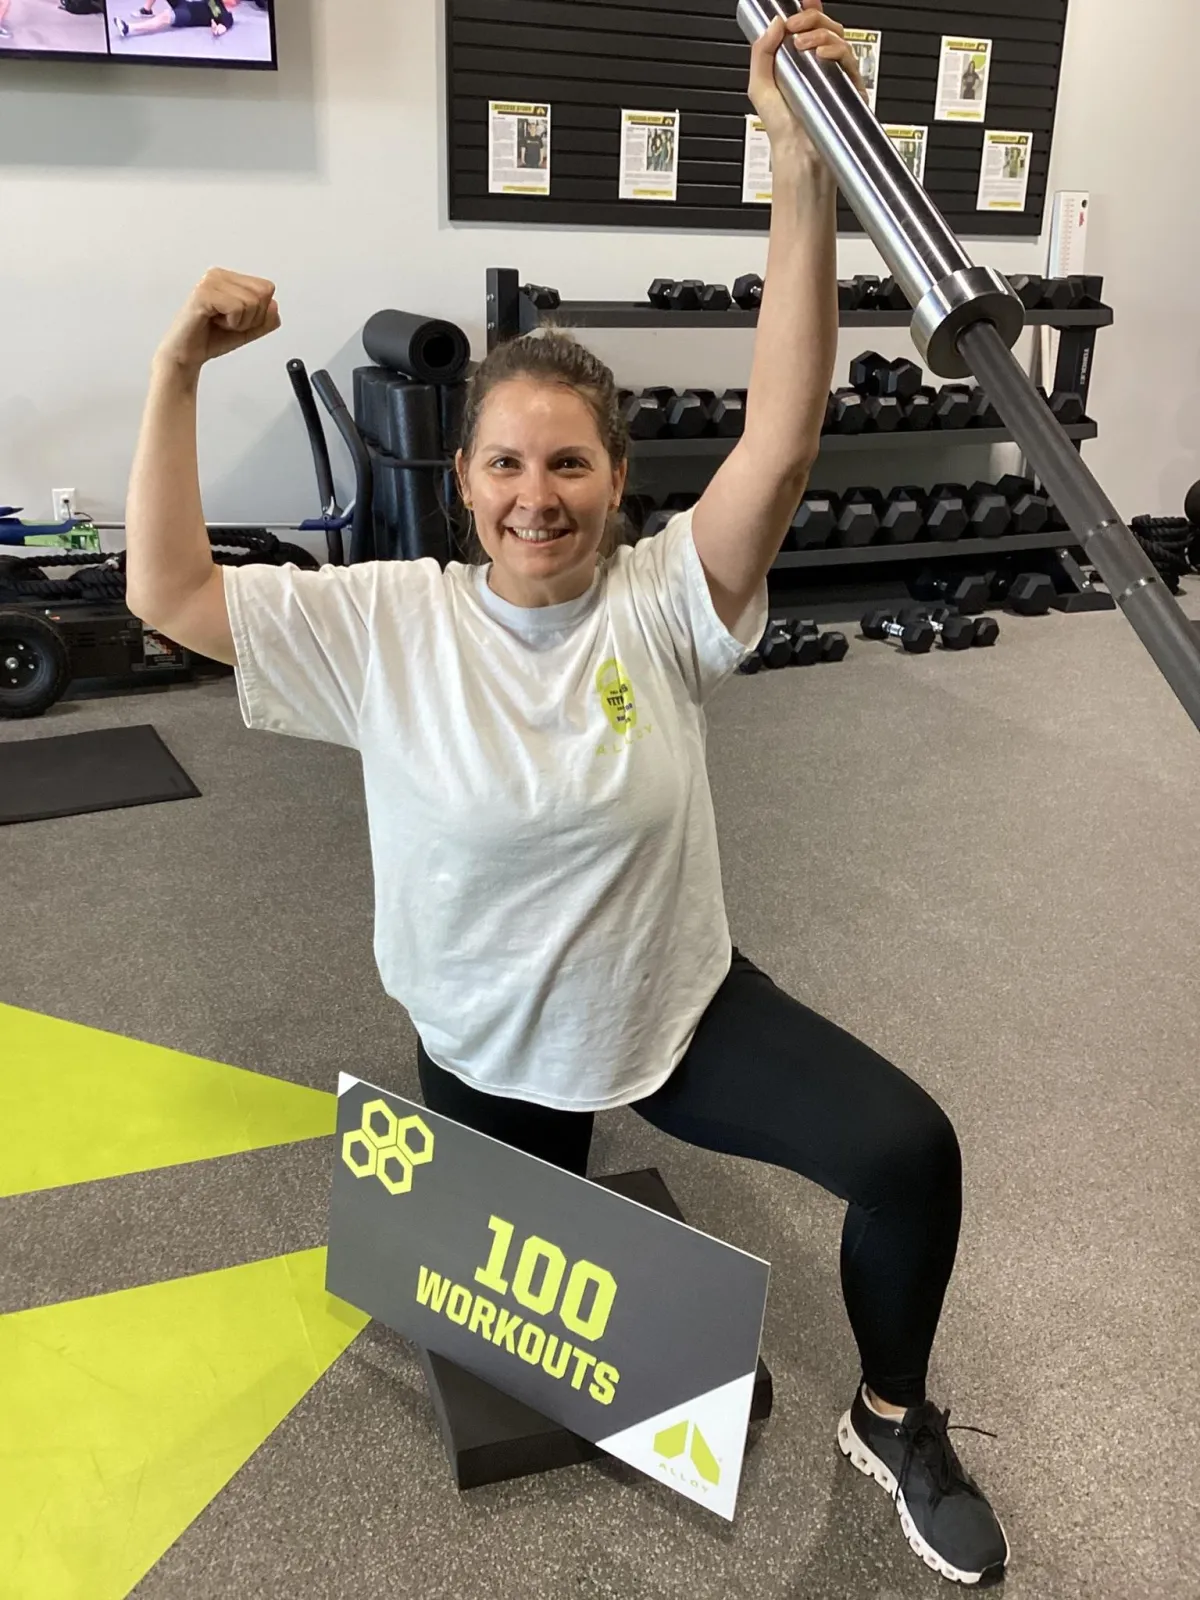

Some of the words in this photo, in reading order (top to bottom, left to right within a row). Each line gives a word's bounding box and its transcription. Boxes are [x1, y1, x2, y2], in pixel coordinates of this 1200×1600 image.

[415, 1265, 620, 1405] WORKOUTS
[474, 1215, 617, 1341] 100
[657, 1463, 708, 1493] ALLOY
